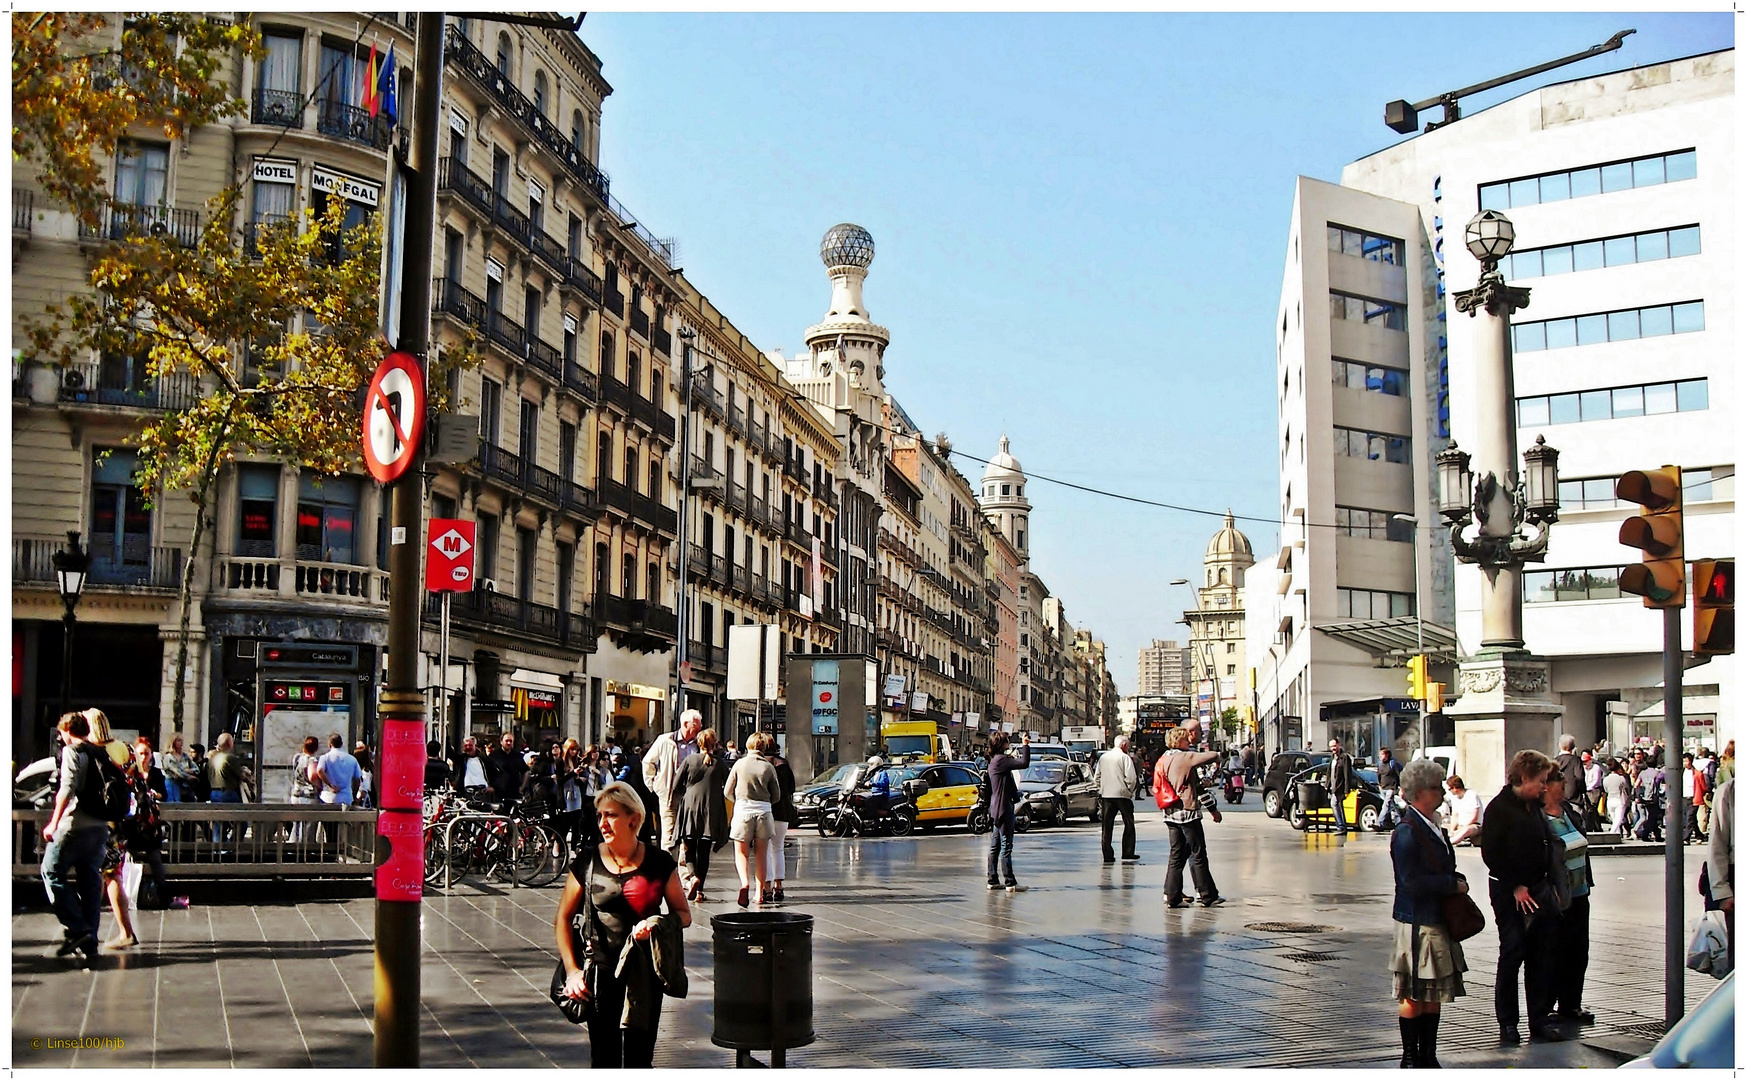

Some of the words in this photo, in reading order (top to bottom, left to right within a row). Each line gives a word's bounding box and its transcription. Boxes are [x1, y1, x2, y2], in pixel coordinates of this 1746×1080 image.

[255, 165, 294, 179] HOTEL
[443, 536, 461, 552] M
[312, 653, 347, 664] Catalunya
[289, 689, 301, 697] L3
[305, 689, 315, 697] L1
